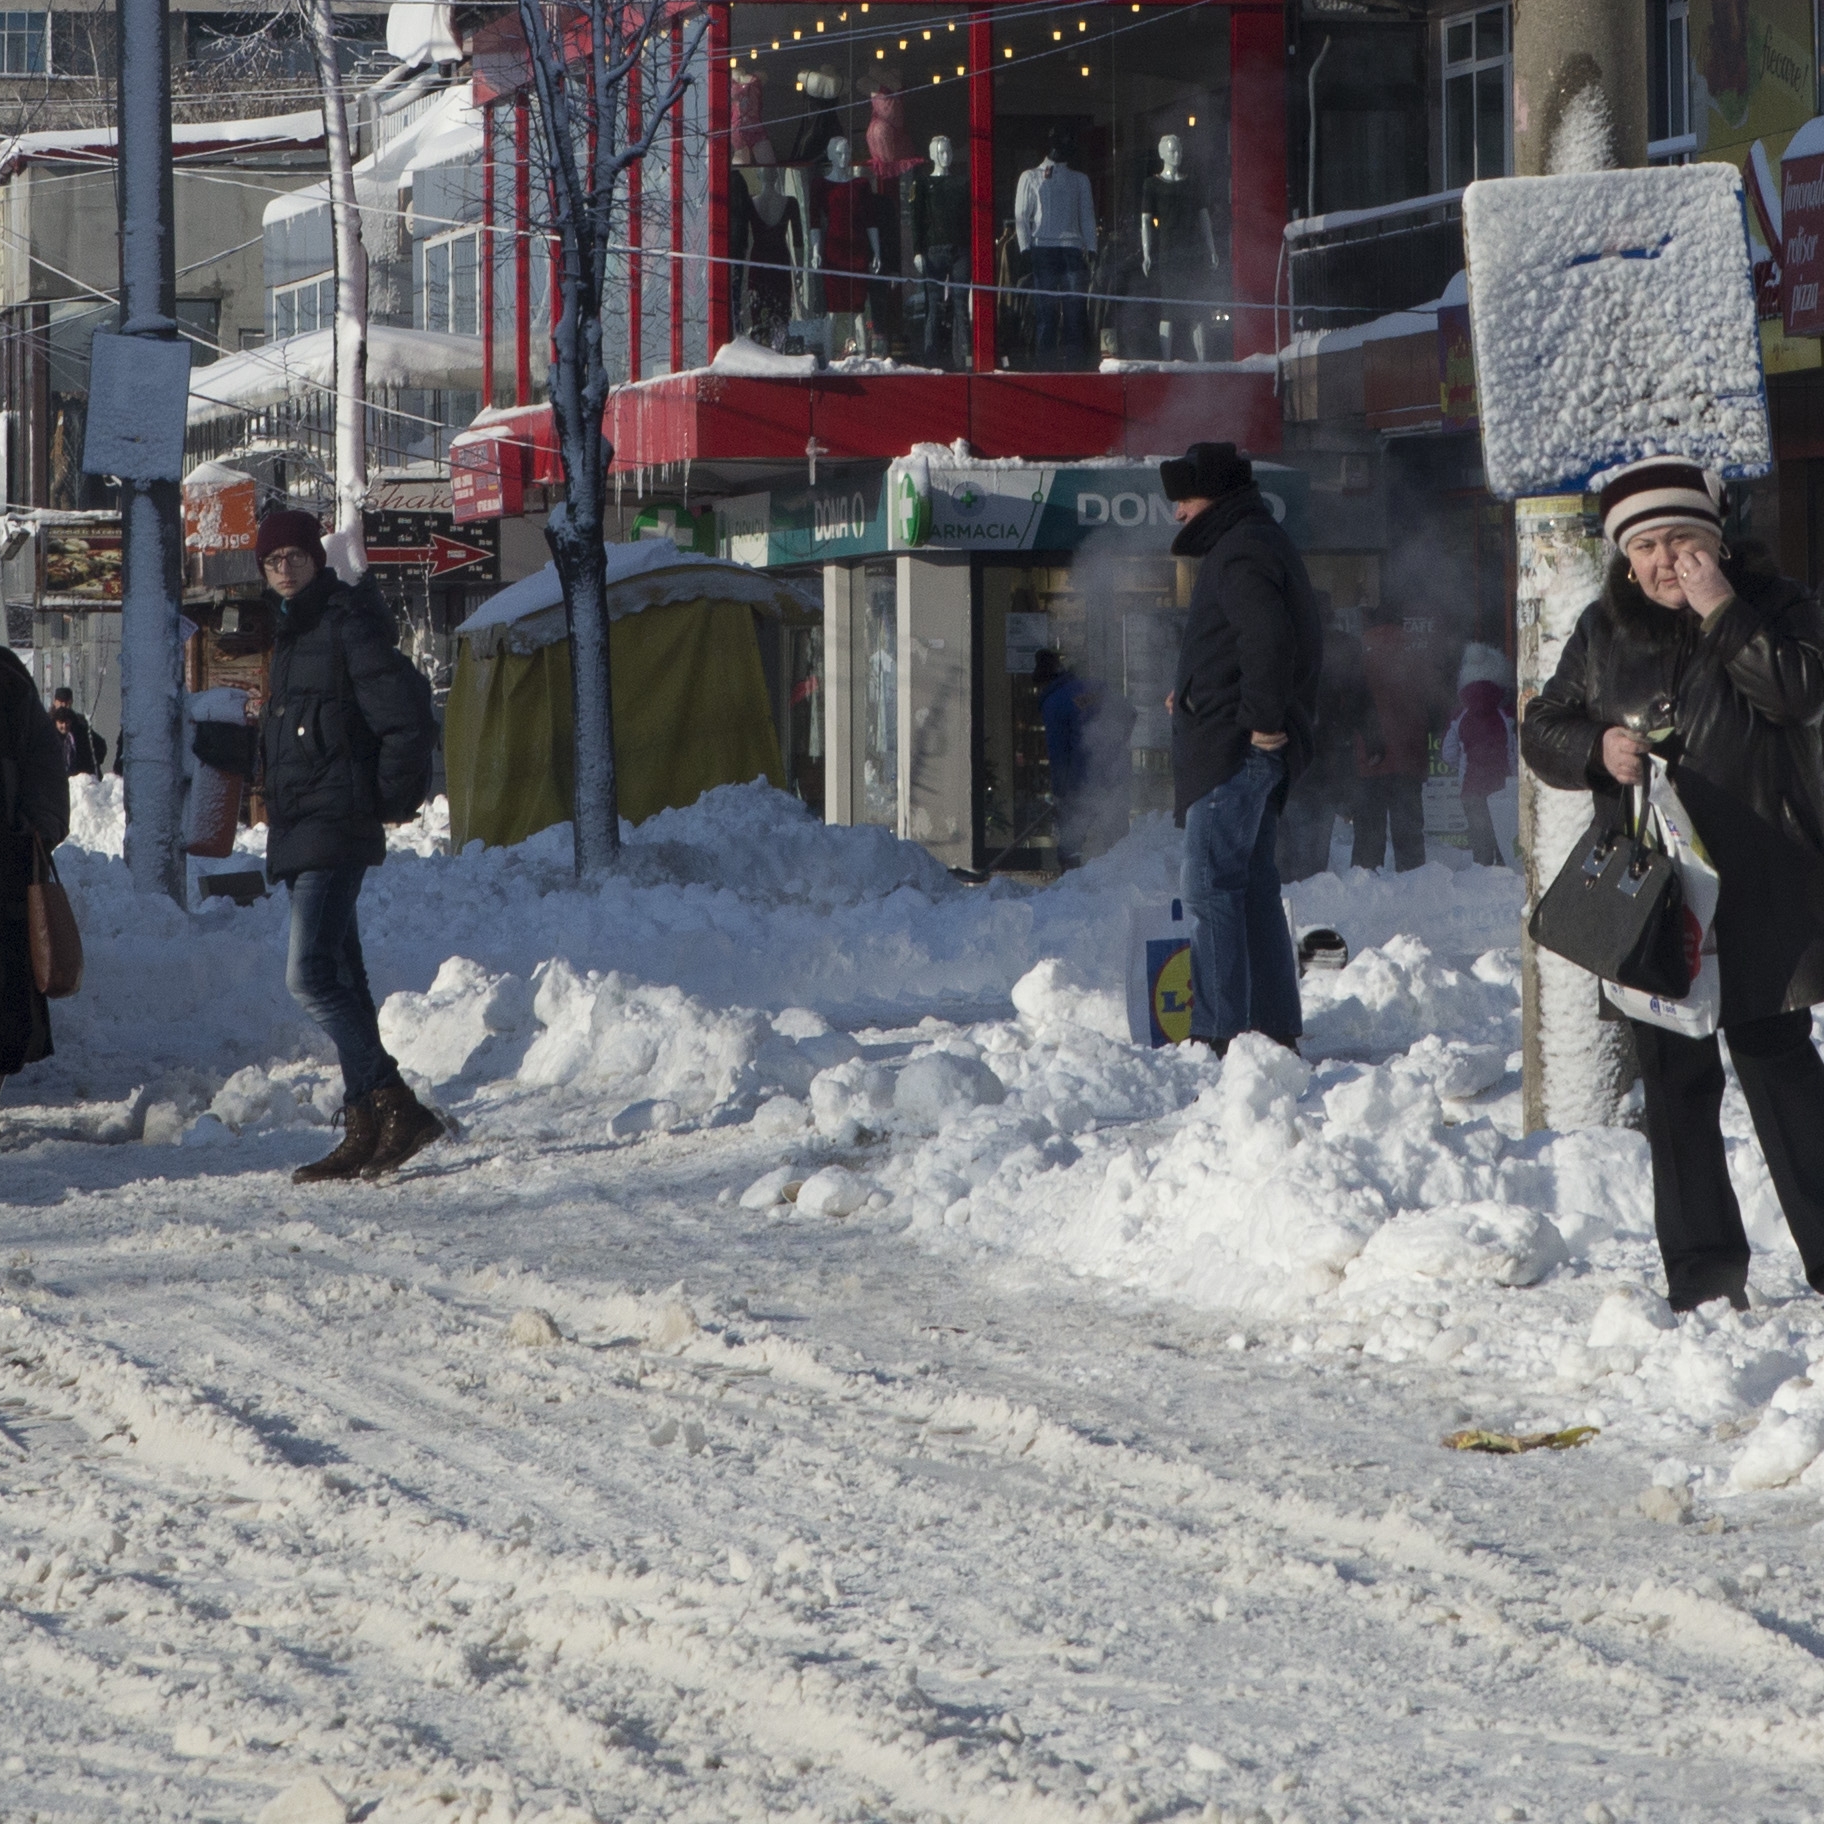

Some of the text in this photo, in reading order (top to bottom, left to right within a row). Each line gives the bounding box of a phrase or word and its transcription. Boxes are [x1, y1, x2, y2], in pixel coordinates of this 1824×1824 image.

[1790, 275, 1819, 327] pizza
[814, 496, 848, 542] DONA
[1077, 492, 1176, 527] DON
[930, 523, 1020, 540] ARMACIA
